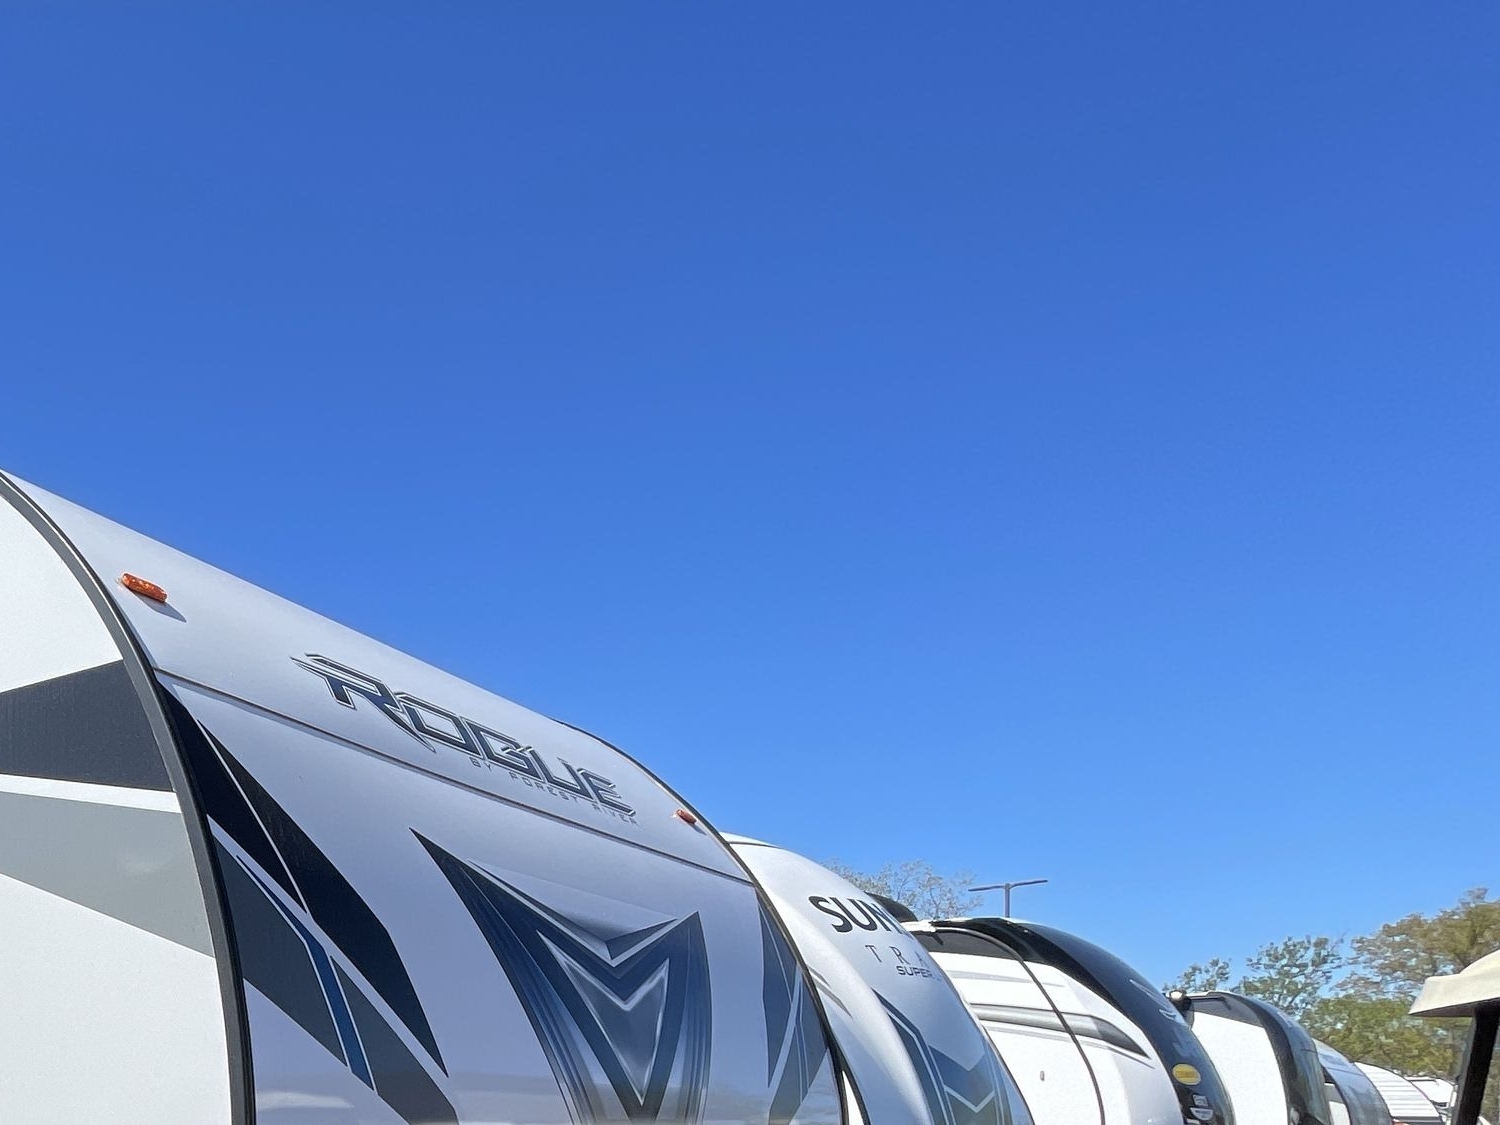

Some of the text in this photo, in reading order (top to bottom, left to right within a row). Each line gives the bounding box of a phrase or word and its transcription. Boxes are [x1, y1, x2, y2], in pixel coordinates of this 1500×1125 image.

[290, 652, 637, 817] ROGUE
[469, 756, 492, 772] BY
[808, 895, 908, 938] SUN
